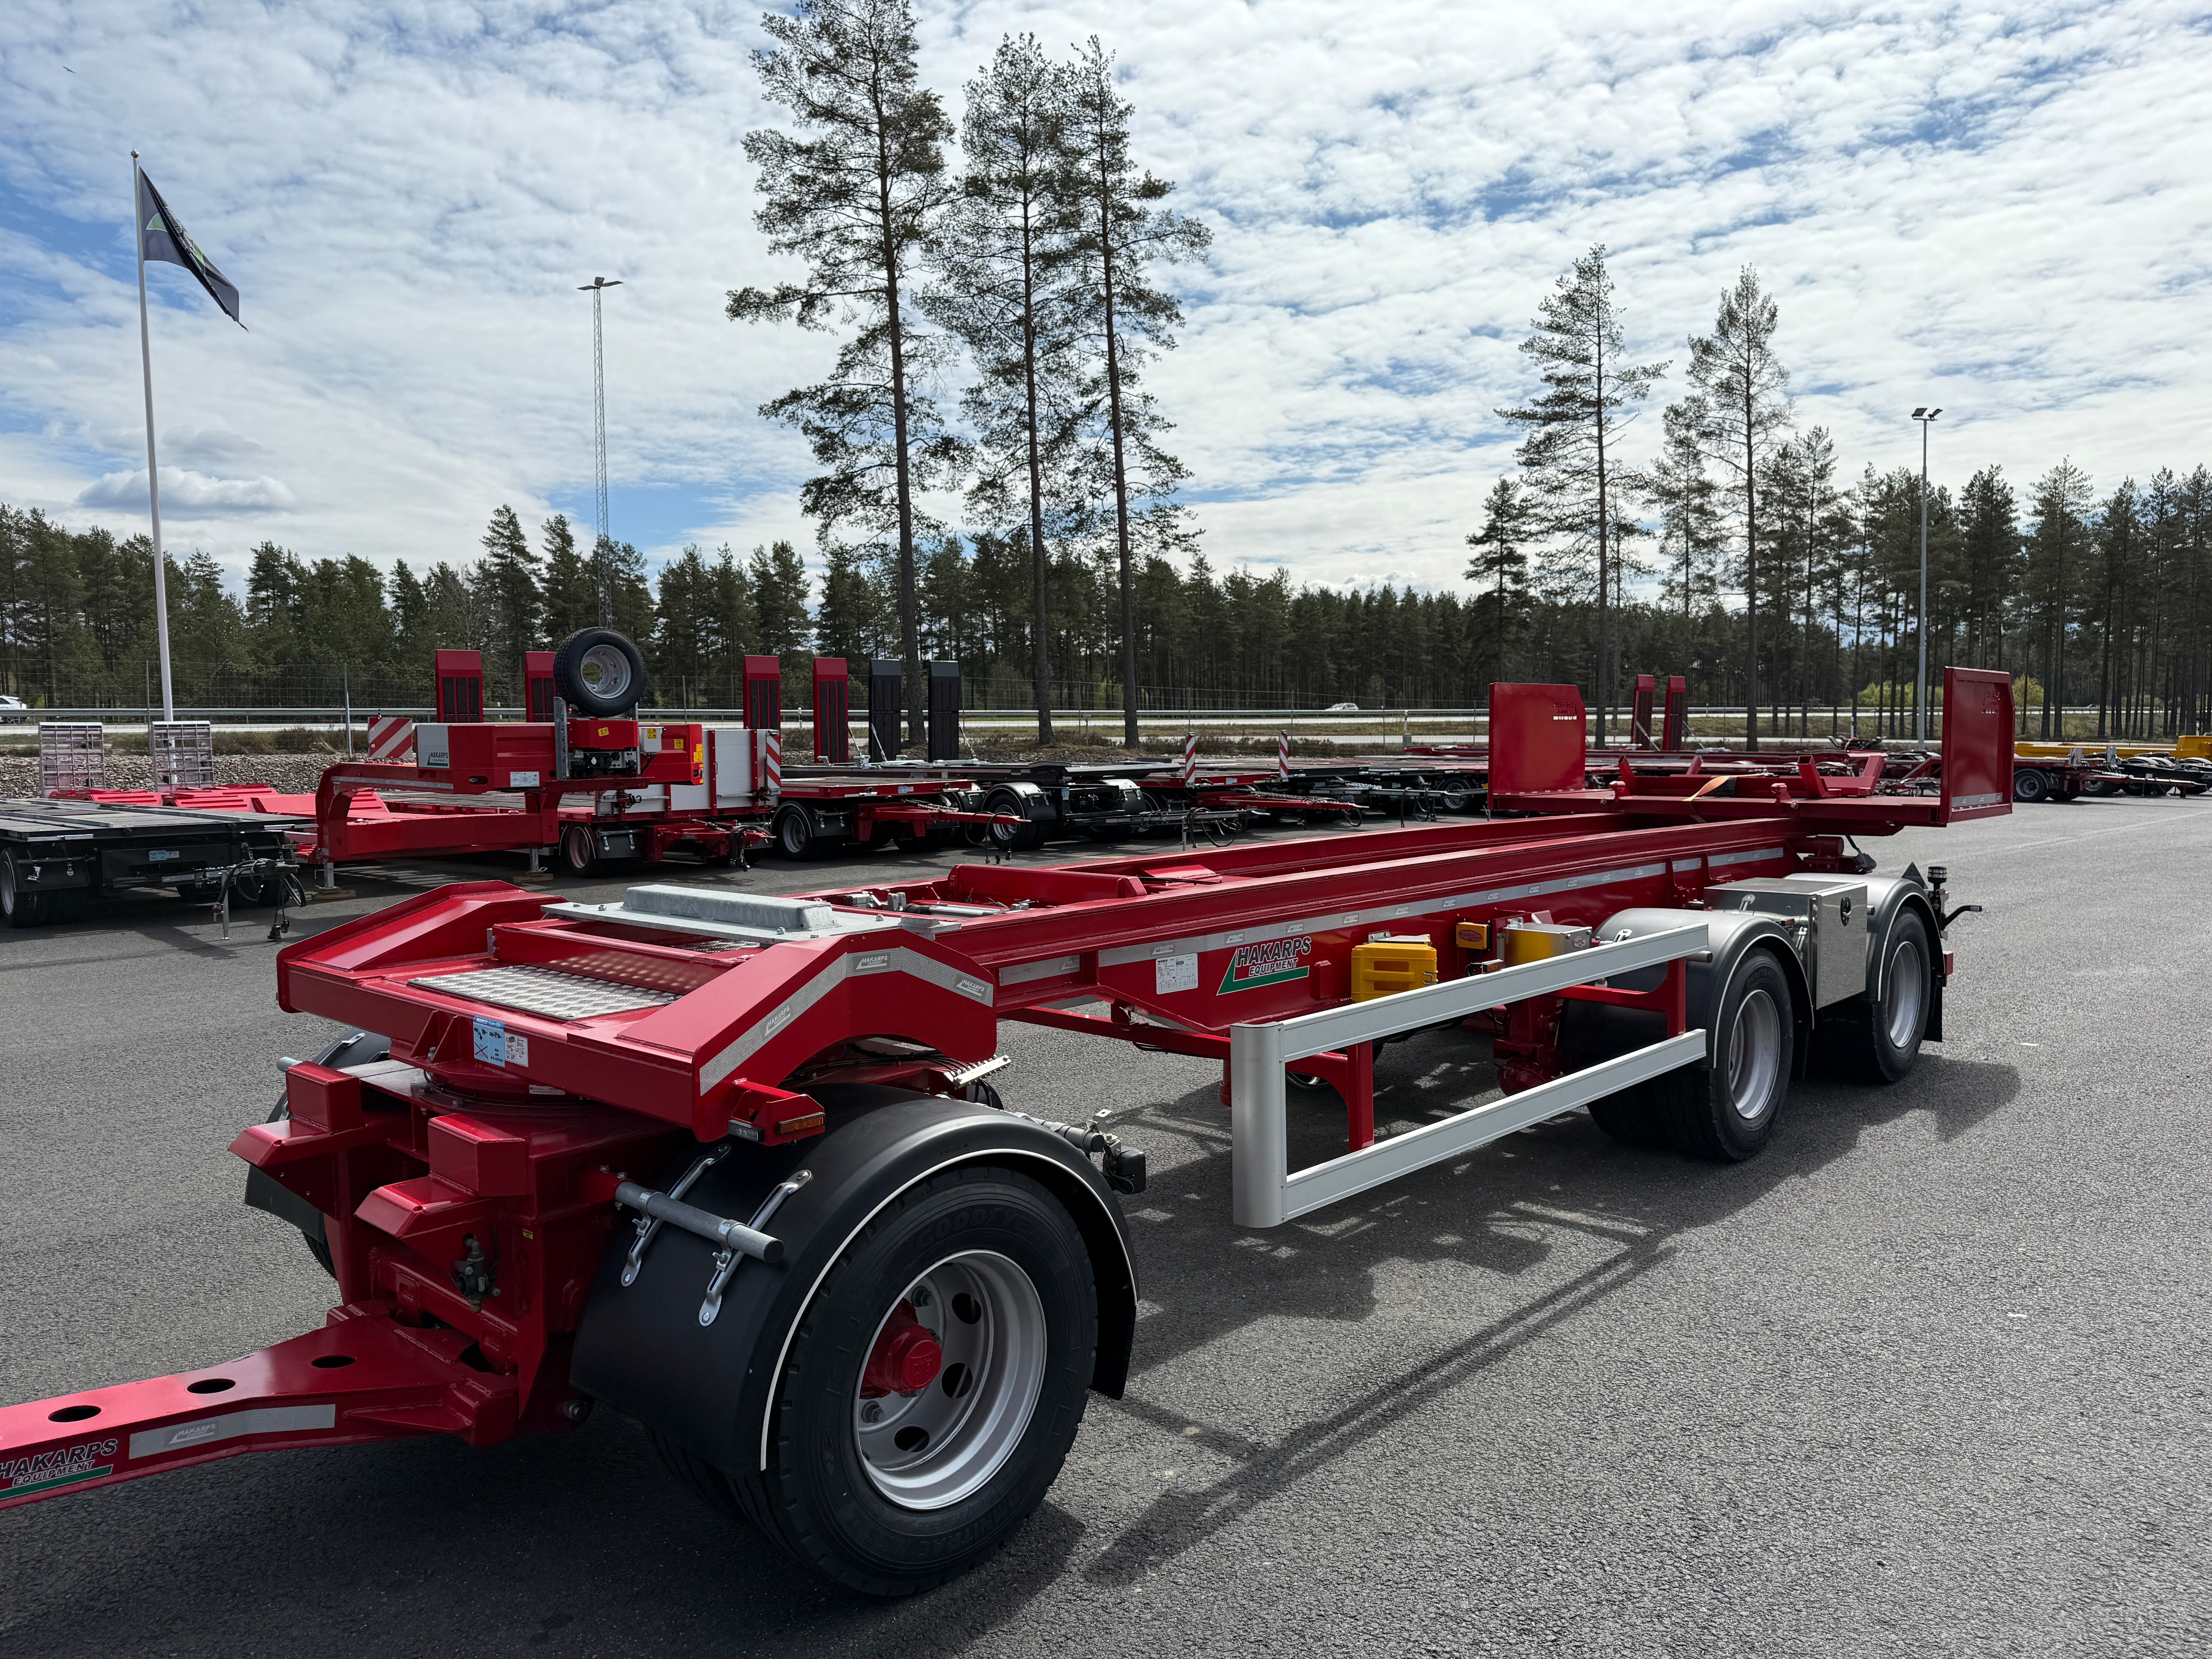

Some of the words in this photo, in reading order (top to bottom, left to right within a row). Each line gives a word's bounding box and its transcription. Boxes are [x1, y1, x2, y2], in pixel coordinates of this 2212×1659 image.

[862, 955, 888, 963] HAKARPS
[1236, 936, 1312, 967] HAKARPS
[1249, 958, 1298, 976] EQUIPMENT
[963, 979, 985, 991] HAKARPS
[768, 1006, 790, 1027] HAKARPS
[179, 1423, 216, 1436] HAKARPS
[0, 1440, 118, 1479] HAKARPS
[12, 1460, 95, 1487] EQUIPMENT
[918, 1490, 1019, 1556] OMNITRAC
